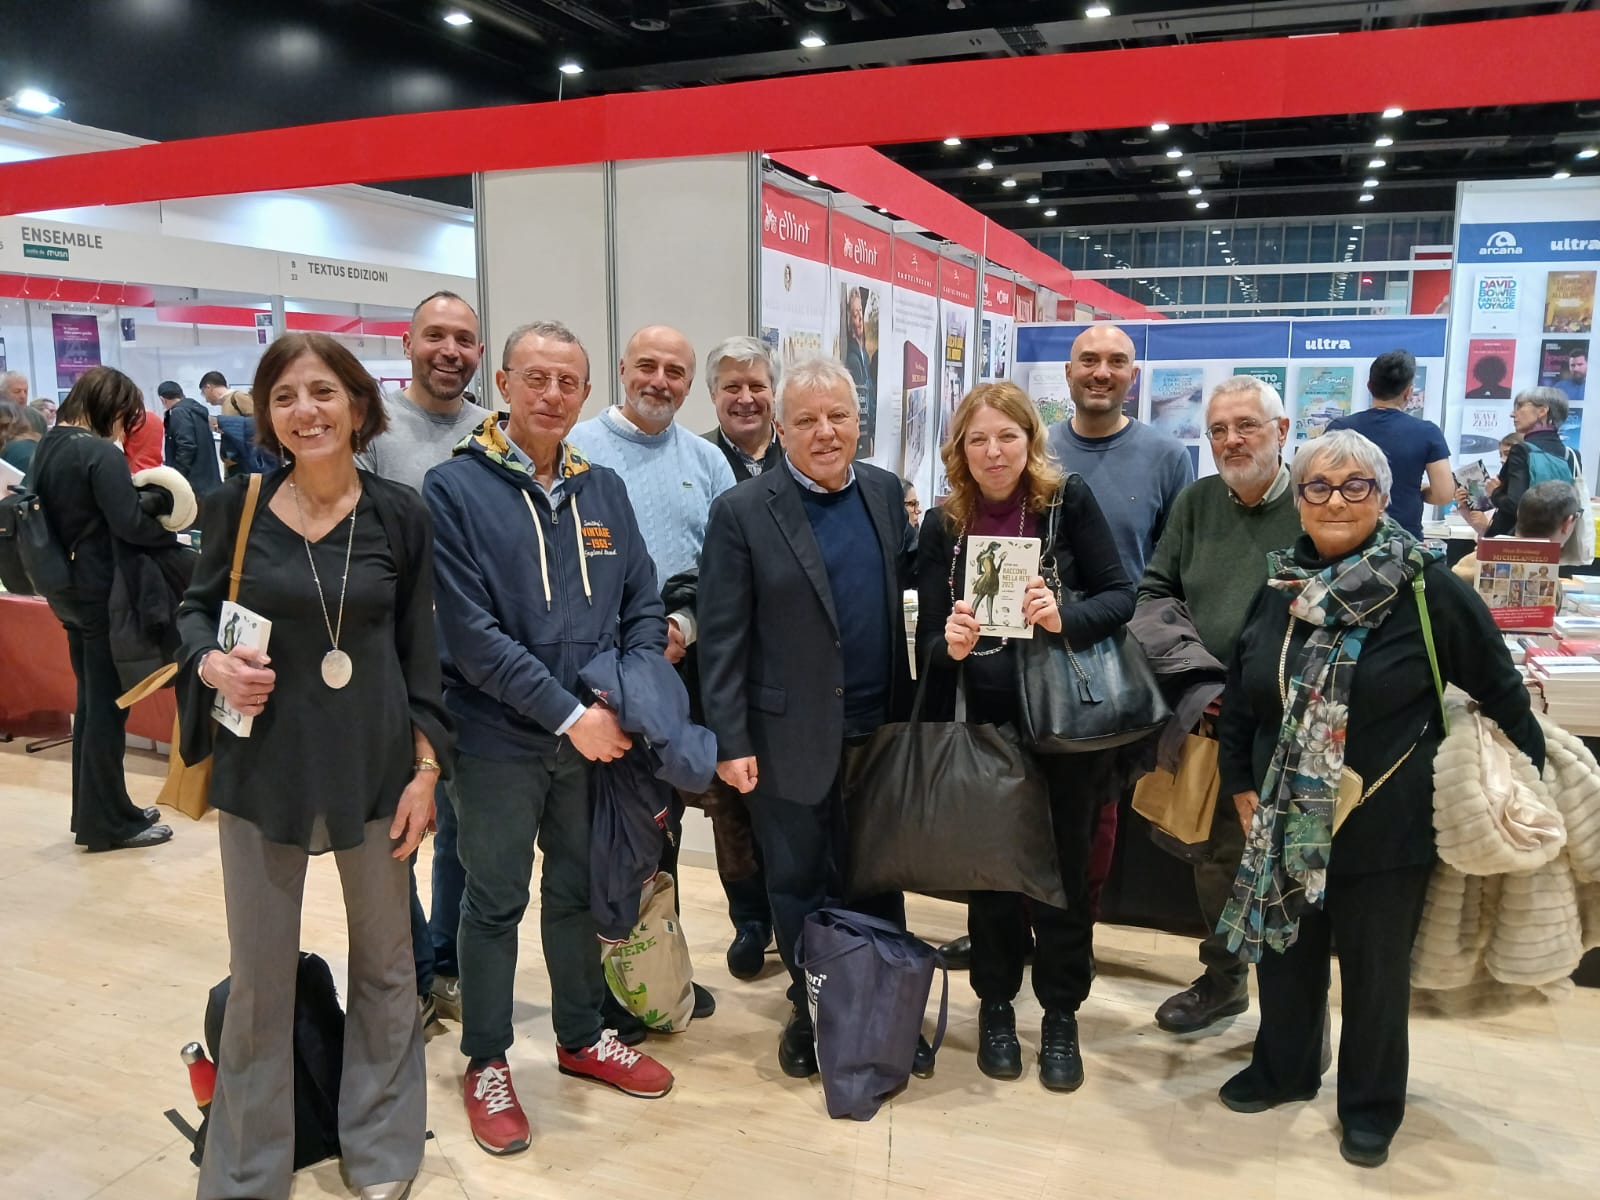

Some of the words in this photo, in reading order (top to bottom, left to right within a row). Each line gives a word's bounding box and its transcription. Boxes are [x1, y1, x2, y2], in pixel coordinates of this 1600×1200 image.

[21, 226, 103, 249] ENSEMBLE
[1551, 239, 1600, 251] ultra
[308, 262, 345, 277] TEXTUS
[347, 267, 388, 282] EDIZIONI
[1480, 280, 1517, 289] DAVID
[1479, 289, 1516, 297] BOWIE
[1478, 302, 1515, 310] VOYAGE
[1305, 338, 1351, 350] ultra
[581, 527, 611, 538] VINTAGE
